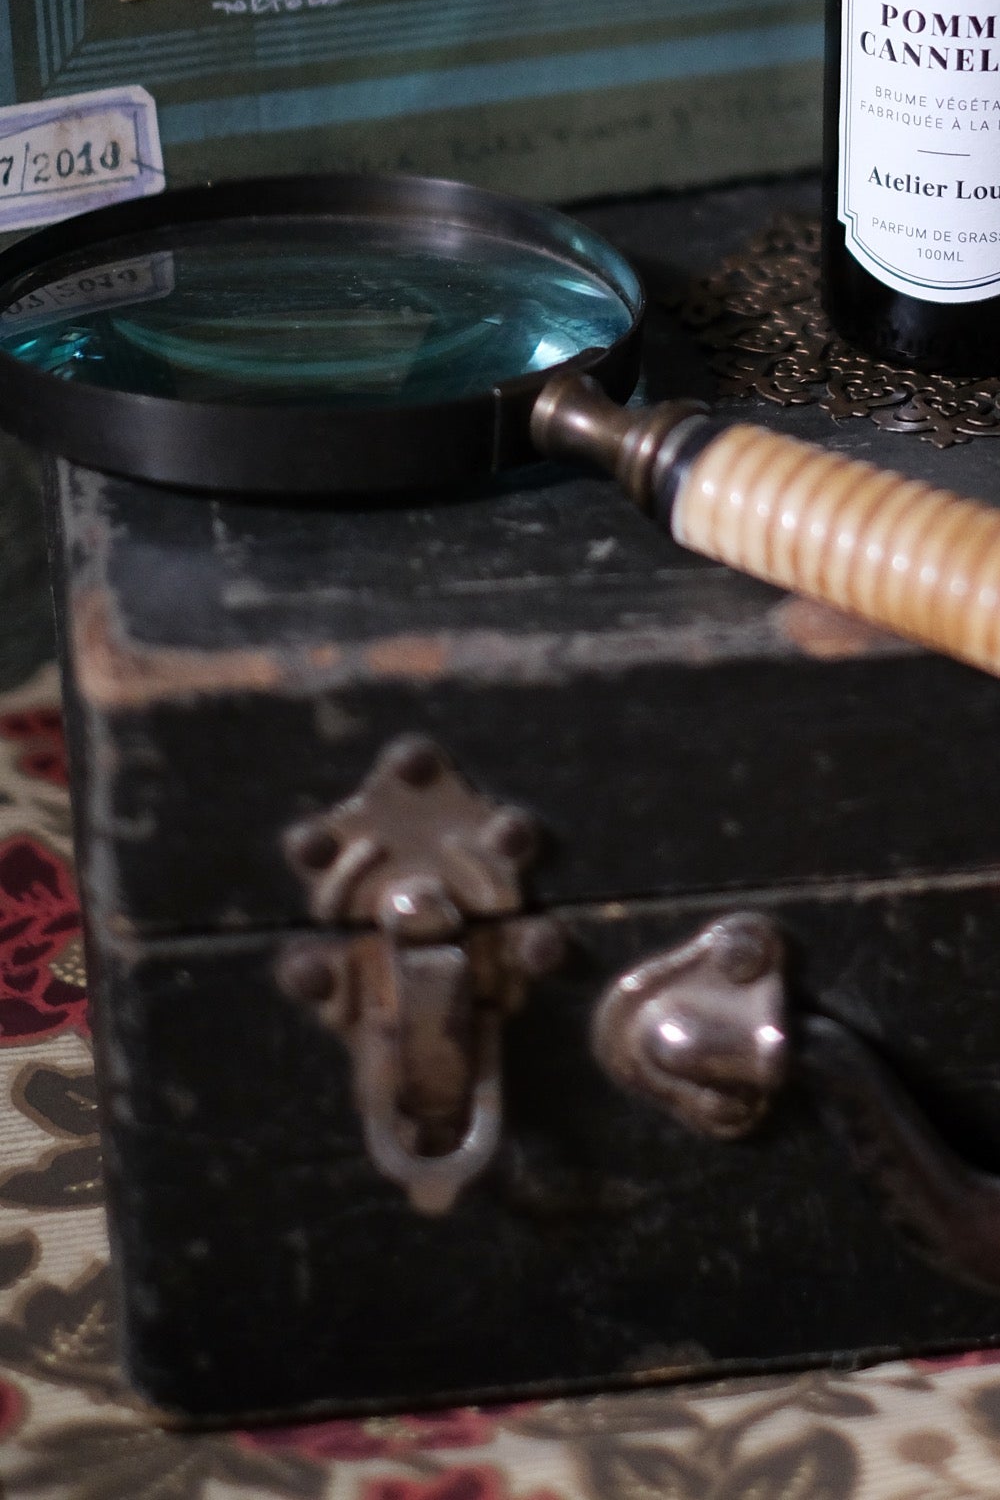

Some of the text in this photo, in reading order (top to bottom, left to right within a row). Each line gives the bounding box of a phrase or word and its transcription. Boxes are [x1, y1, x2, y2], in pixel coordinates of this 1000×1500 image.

[875, 85, 927, 108] BRUME
[860, 100, 944, 130] FABRIQUÉE
[951, 116, 961, 131] À
[970, 119, 990, 131] LA
[868, 165, 949, 198] Atelier
[872, 217, 927, 240] PARFUM
[933, 230, 952, 242] DE
[917, 247, 964, 263] 100ML
